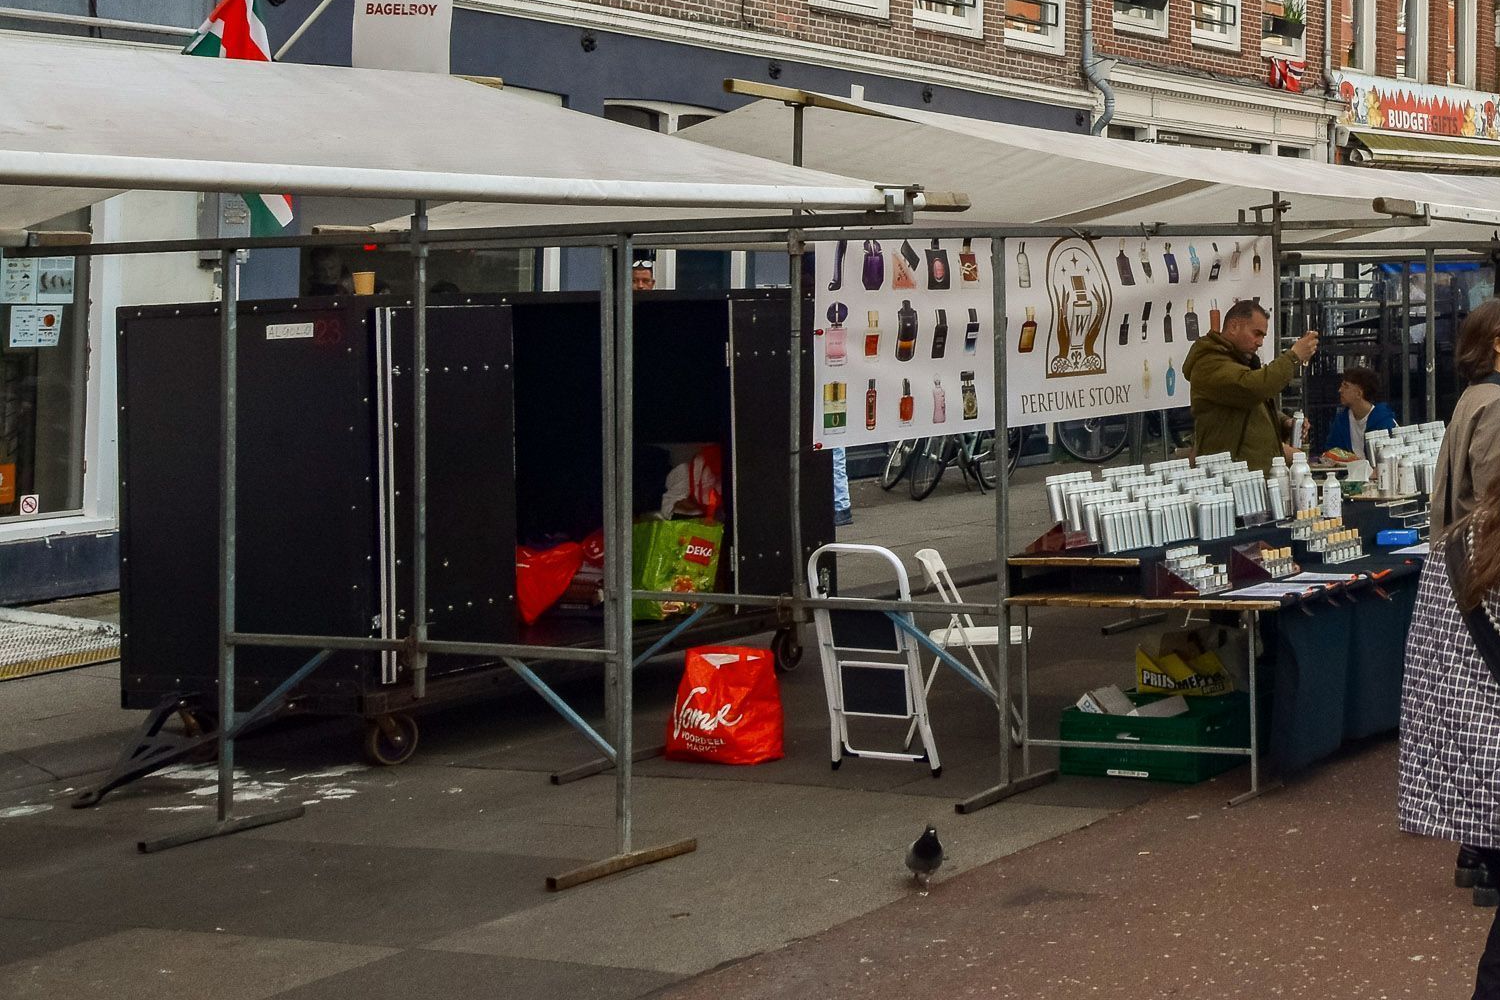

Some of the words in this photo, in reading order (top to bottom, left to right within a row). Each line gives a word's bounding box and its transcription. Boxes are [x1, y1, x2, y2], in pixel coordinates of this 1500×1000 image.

[365, 3, 438, 16] BAGELBOY
[1388, 109, 1429, 131] BUDGET
[1431, 115, 1458, 135] GIFTS
[1021, 389, 1085, 414] PERFUME
[1089, 384, 1131, 407] STORY
